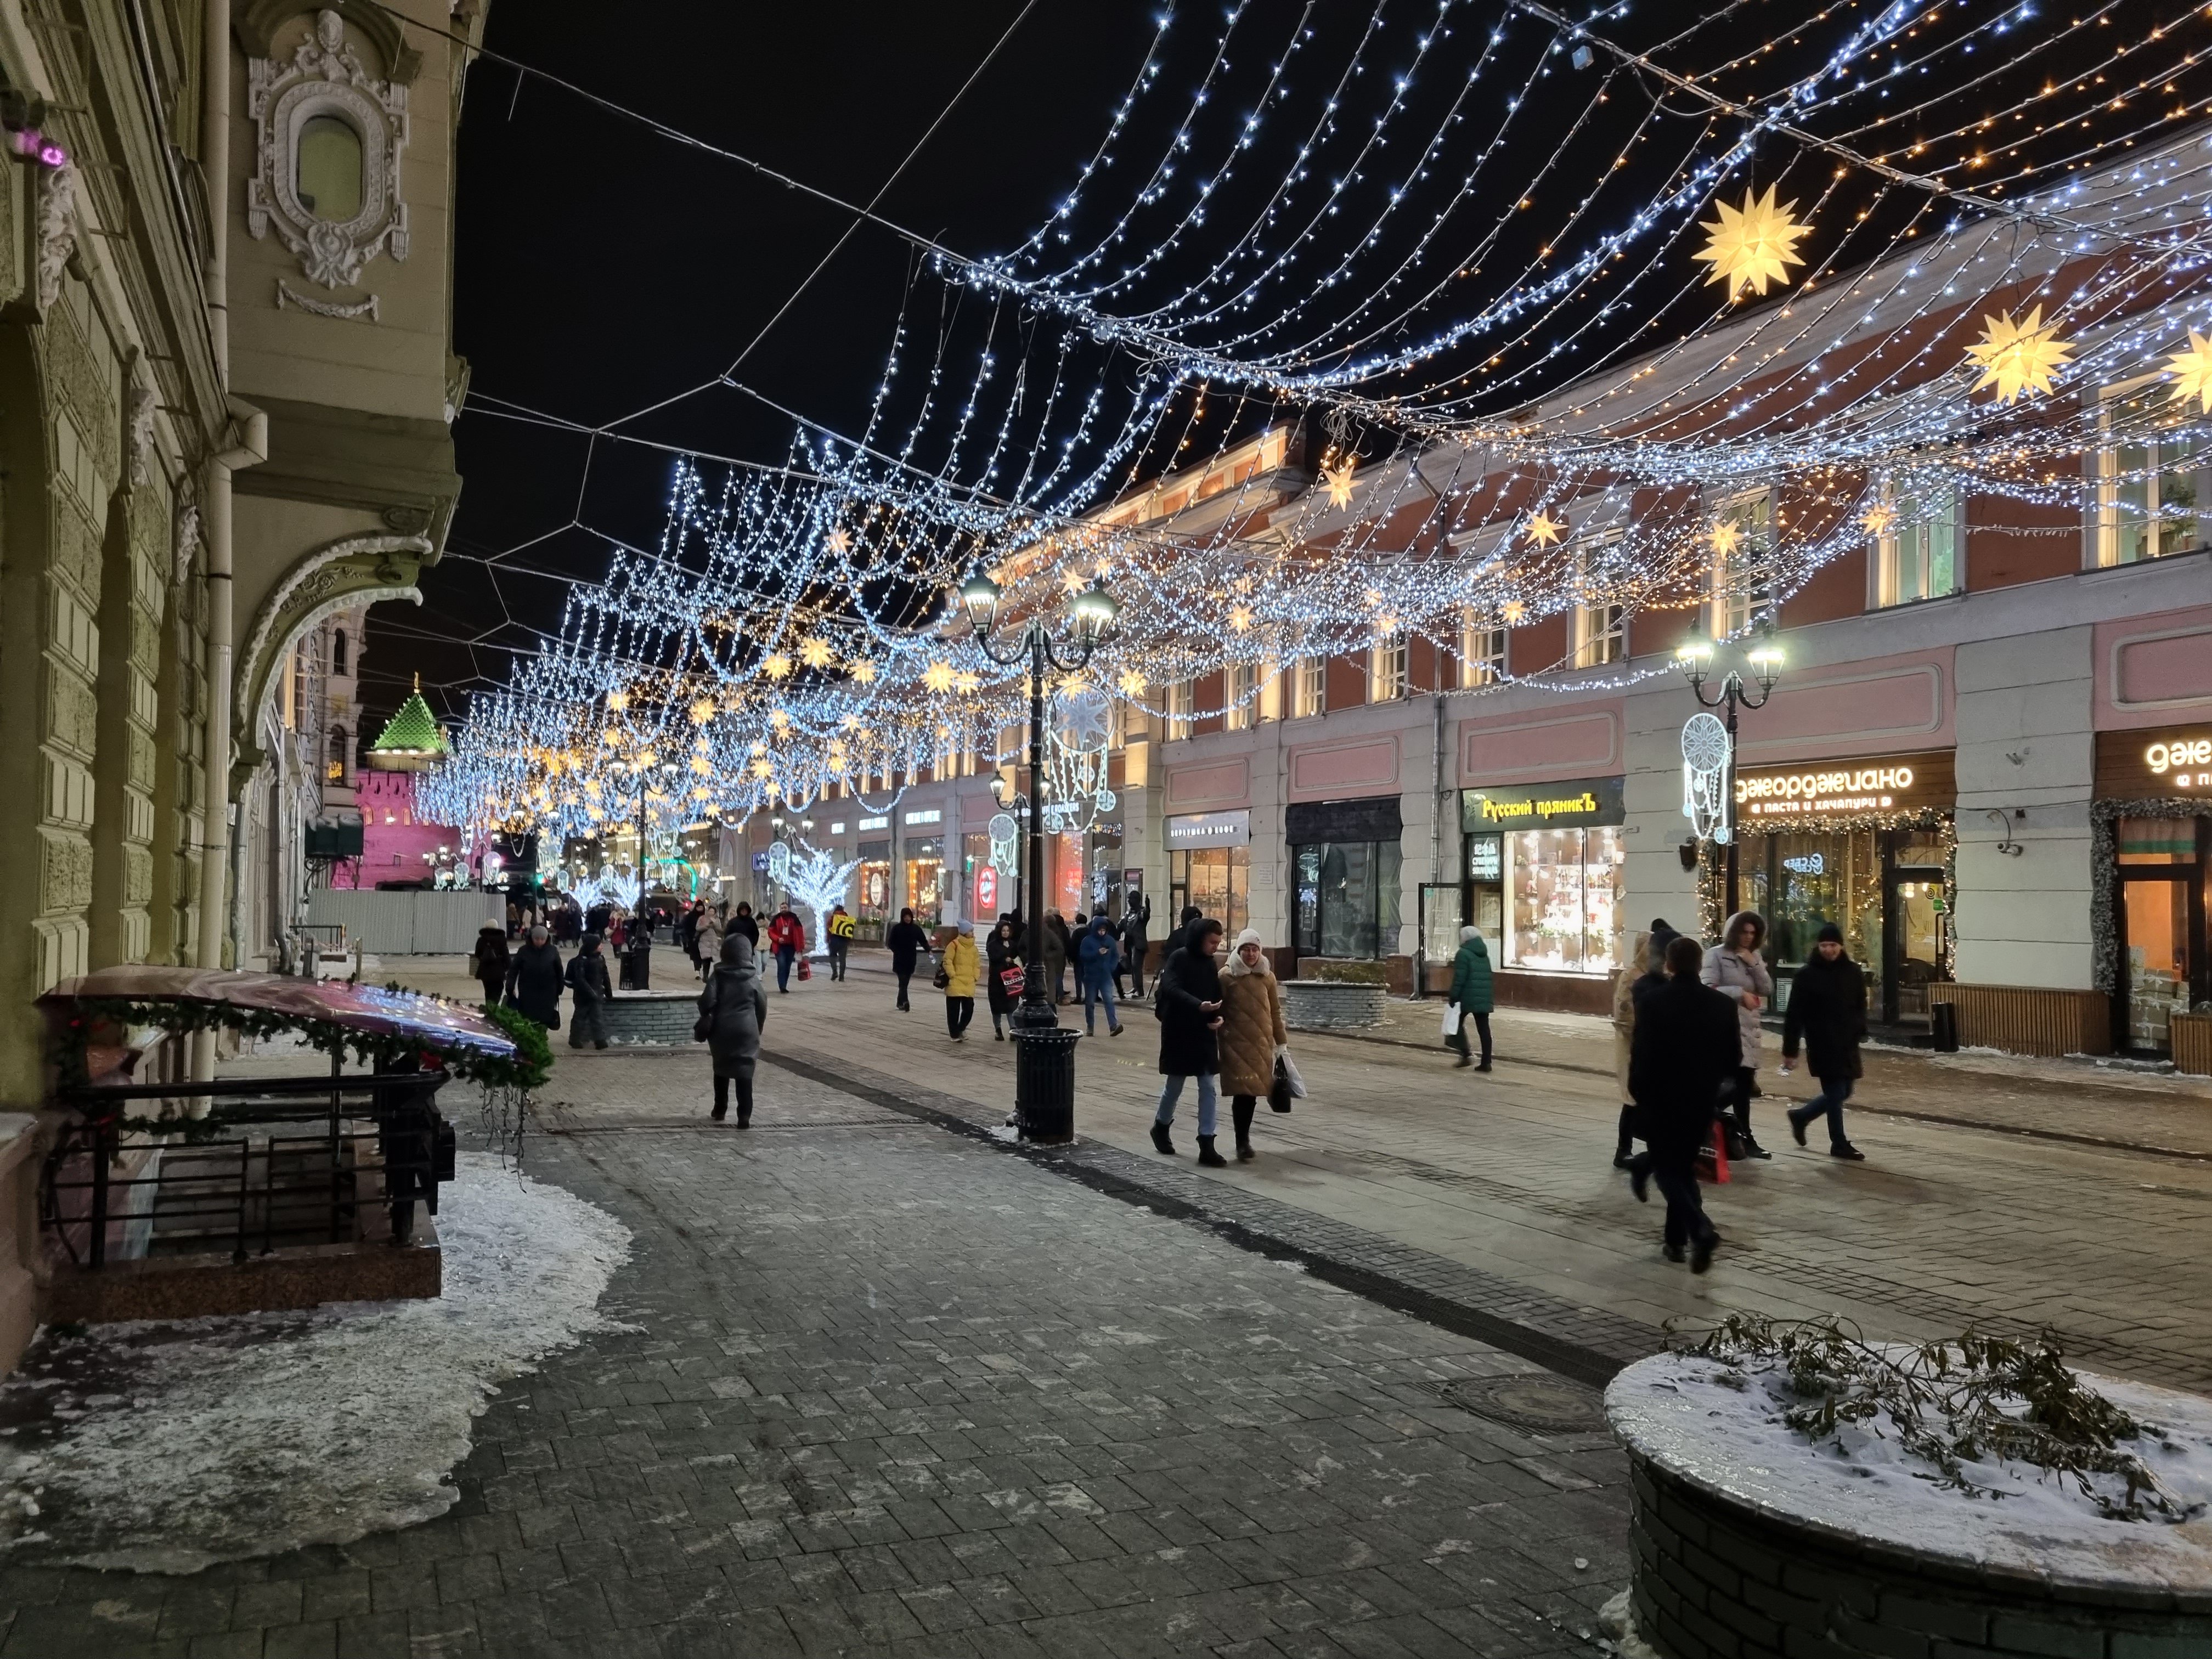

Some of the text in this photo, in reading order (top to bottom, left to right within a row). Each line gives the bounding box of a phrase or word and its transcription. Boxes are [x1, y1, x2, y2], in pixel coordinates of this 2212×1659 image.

[1482, 799, 1533, 823] Русский
[1765, 802, 1799, 813] ПАСТА
[1815, 797, 1876, 810] ХАЧАПУРИ
